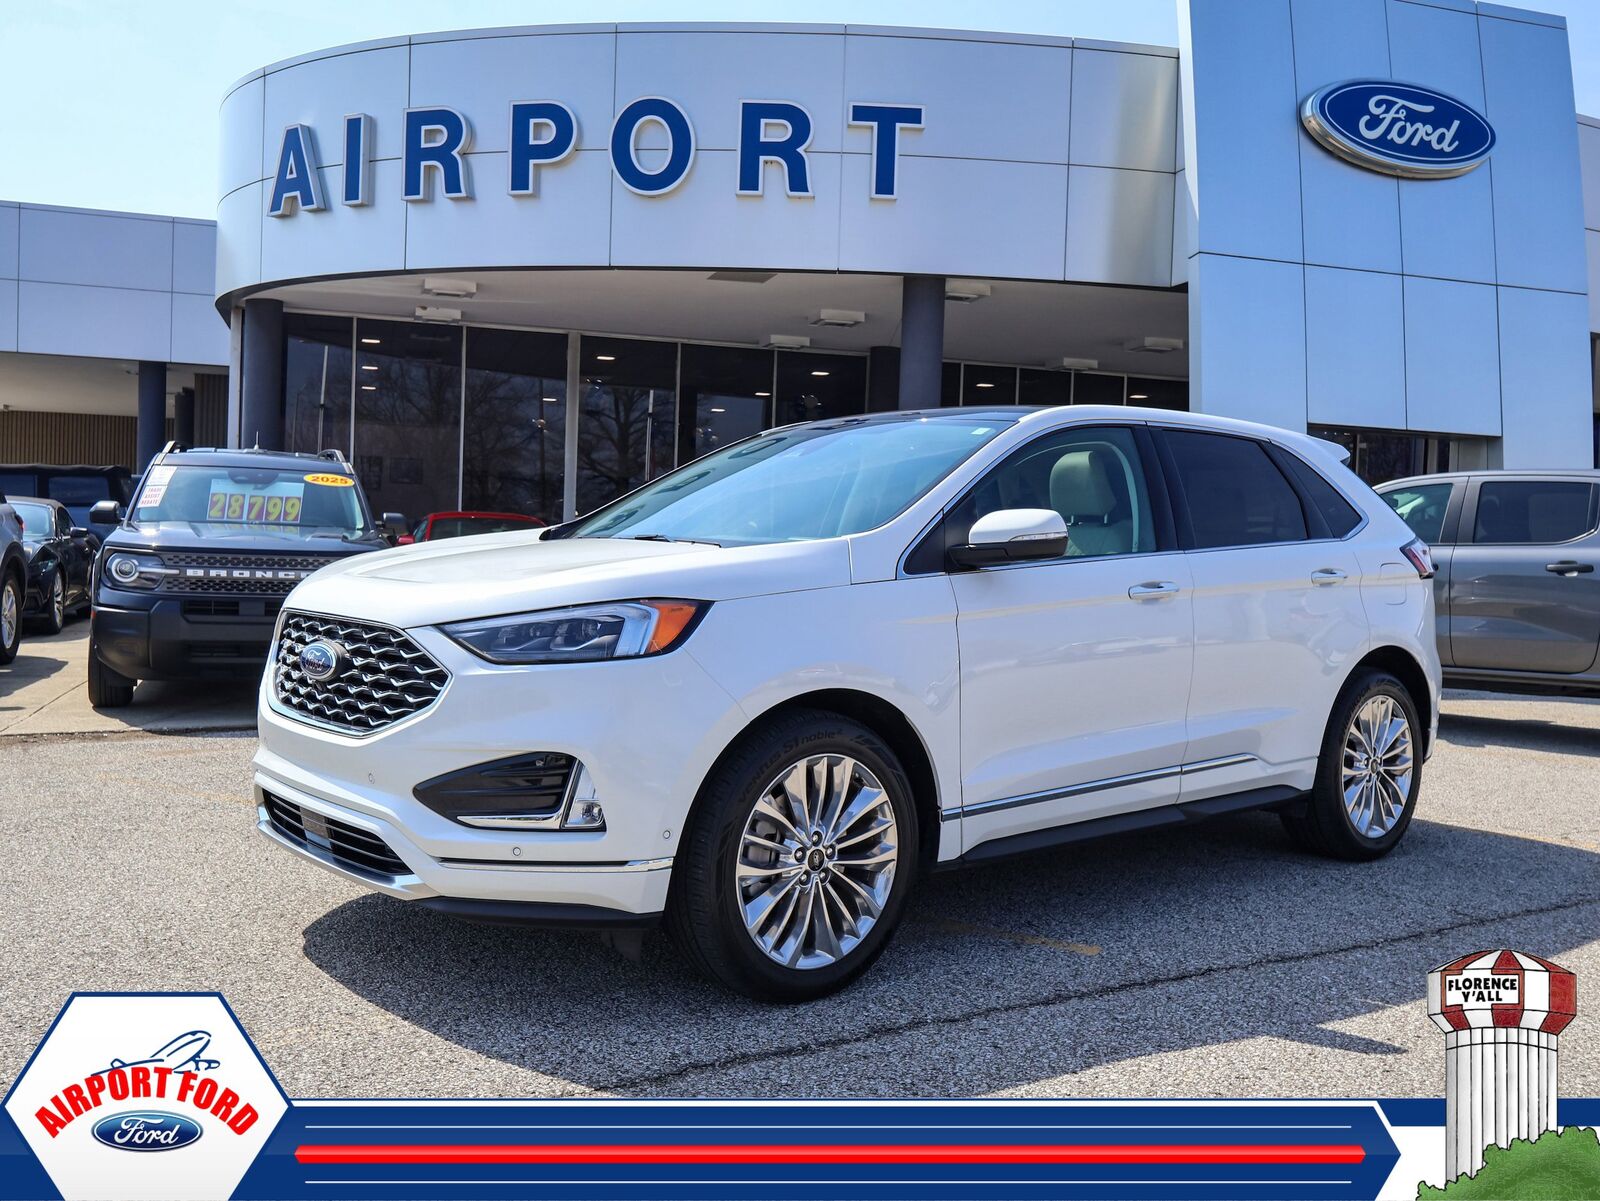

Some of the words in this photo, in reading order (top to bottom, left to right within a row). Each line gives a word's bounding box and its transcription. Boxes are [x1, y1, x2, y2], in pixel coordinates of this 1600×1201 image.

[1358, 94, 1461, 153] Ford
[267, 95, 926, 218] AIRPORT
[311, 475, 349, 485] 2025
[208, 492, 301, 522] 28799
